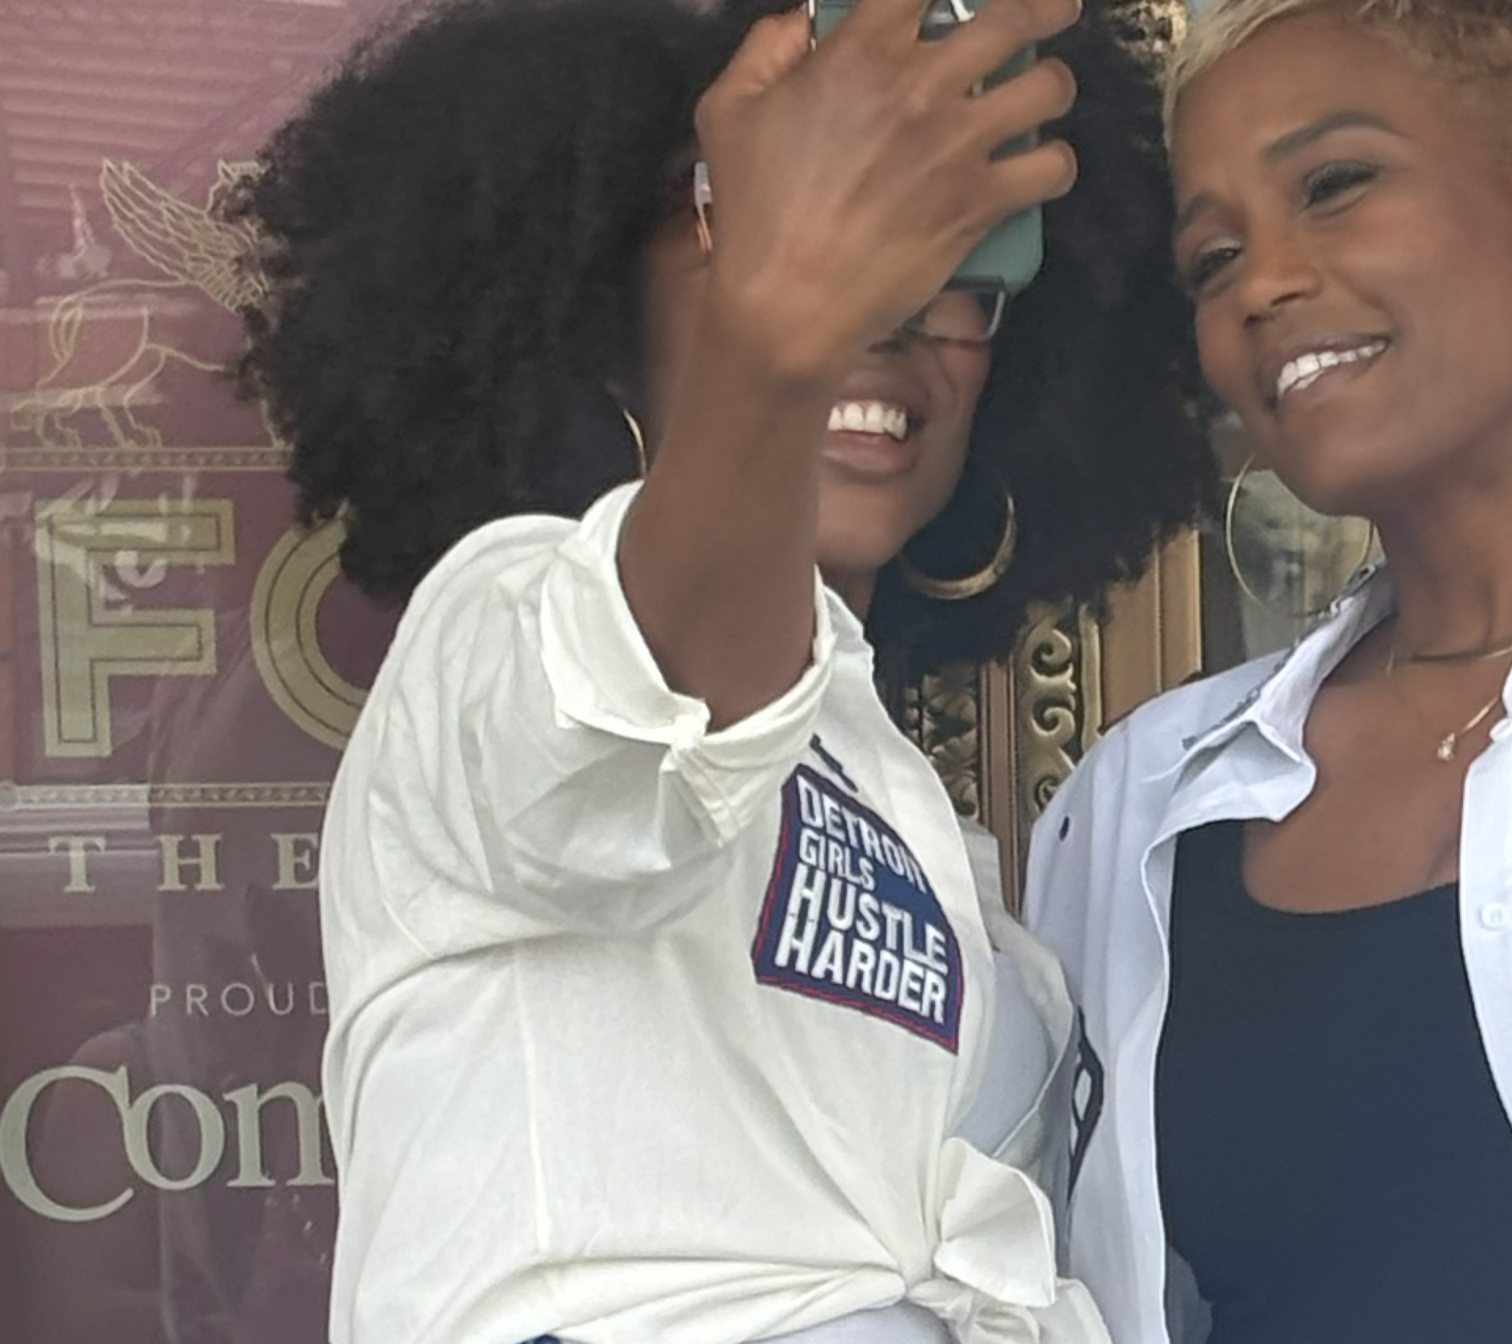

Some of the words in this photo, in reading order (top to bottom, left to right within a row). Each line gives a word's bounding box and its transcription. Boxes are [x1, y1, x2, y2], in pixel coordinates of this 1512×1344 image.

[797, 775, 928, 894] DETROIT
[799, 828, 876, 892] GIRLS
[774, 916, 947, 1025] HARDER
[788, 861, 949, 977] HUSTLE
